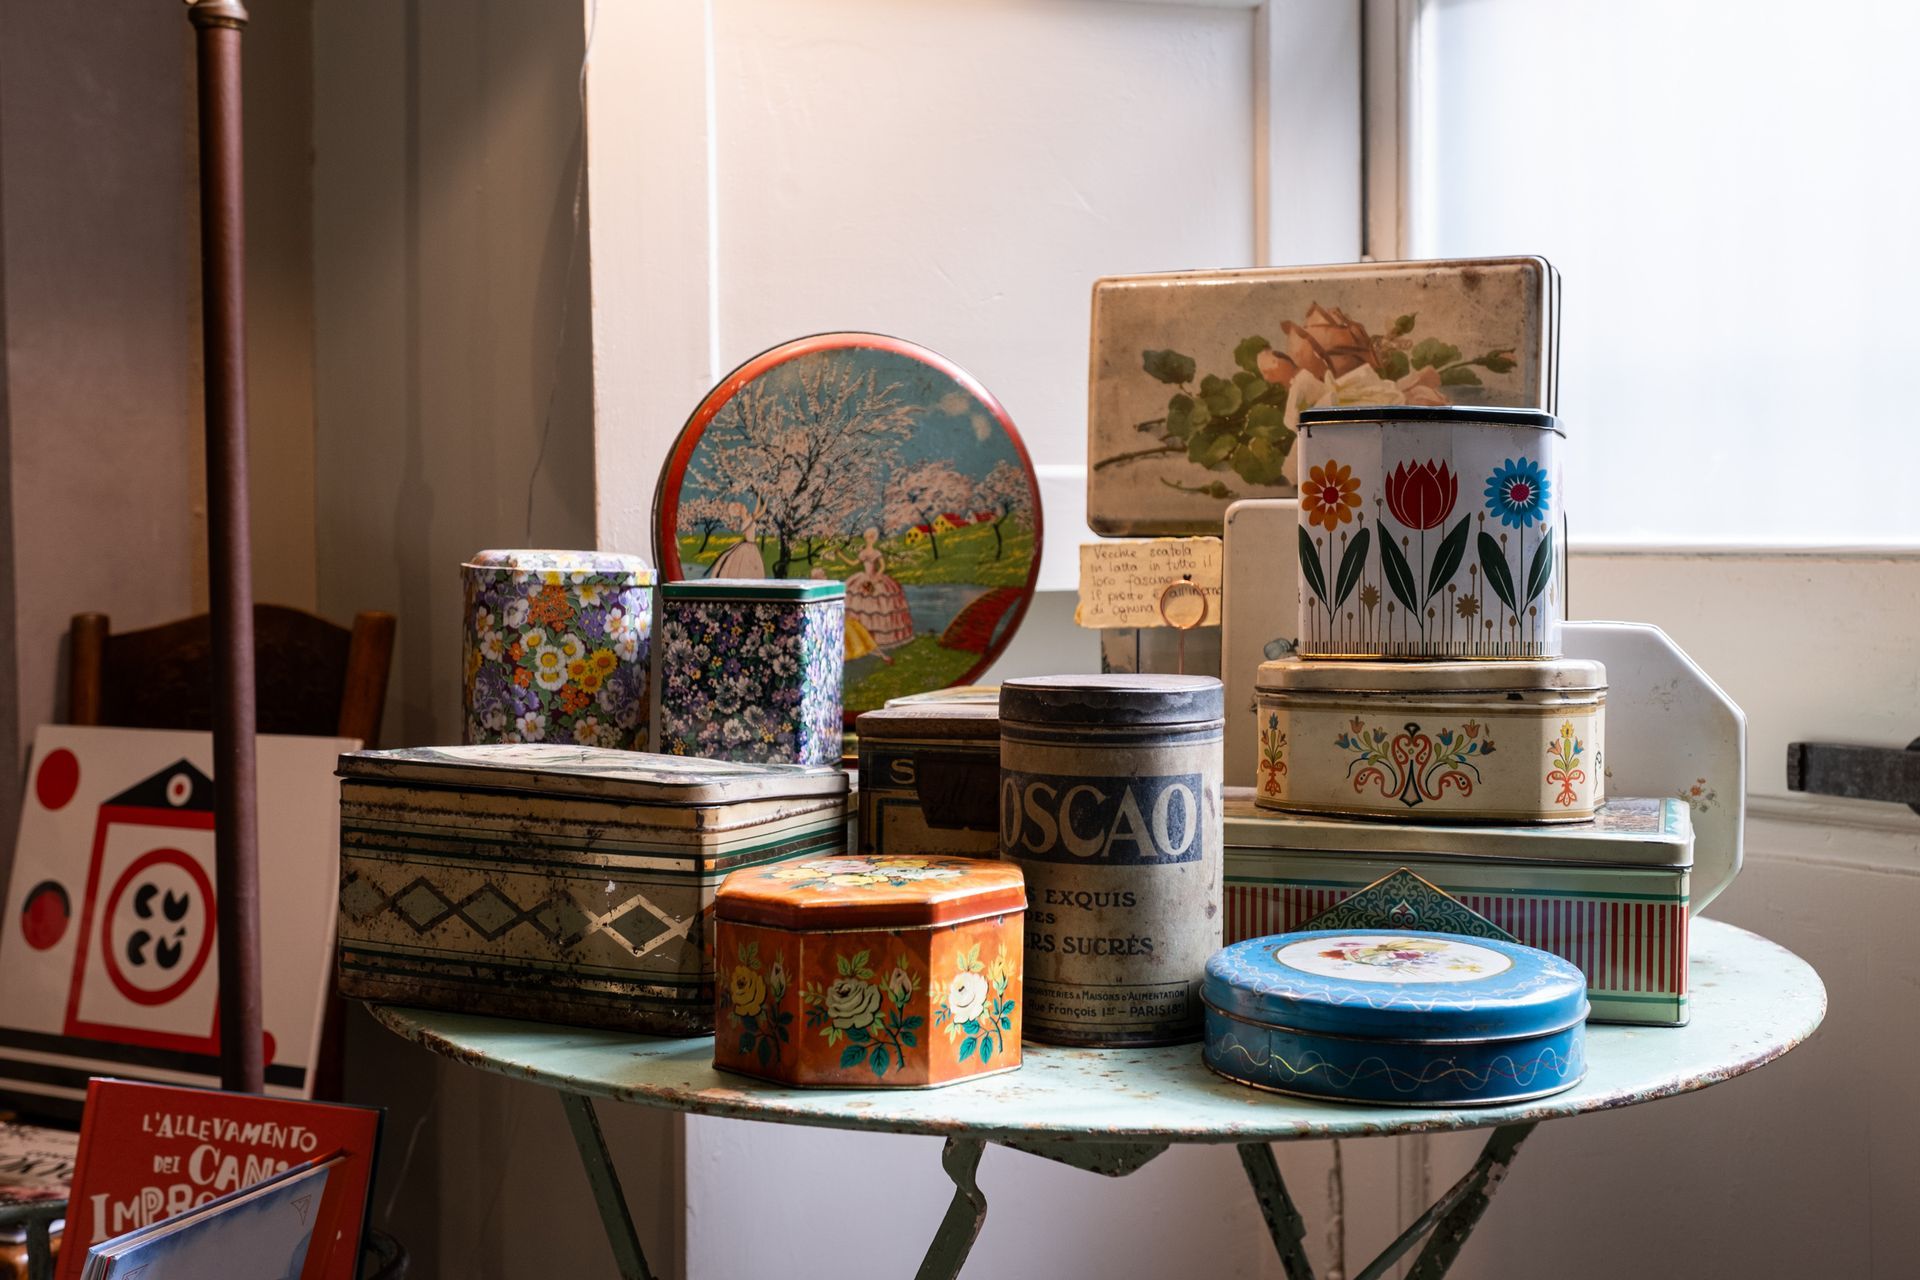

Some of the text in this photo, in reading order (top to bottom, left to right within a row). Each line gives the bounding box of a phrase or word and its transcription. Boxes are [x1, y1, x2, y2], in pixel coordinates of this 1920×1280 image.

[1166, 559, 1196, 571] tutto
[1203, 553, 1212, 569] il
[1090, 603, 1104, 616] di
[1045, 889, 1137, 911] EXQUIS
[1062, 934, 1154, 956] SUCRÉS
[1048, 1003, 1097, 1019] François
[142, 1111, 318, 1153] L'ALLEVAMENTO
[153, 1144, 289, 1192] DEI CAN
